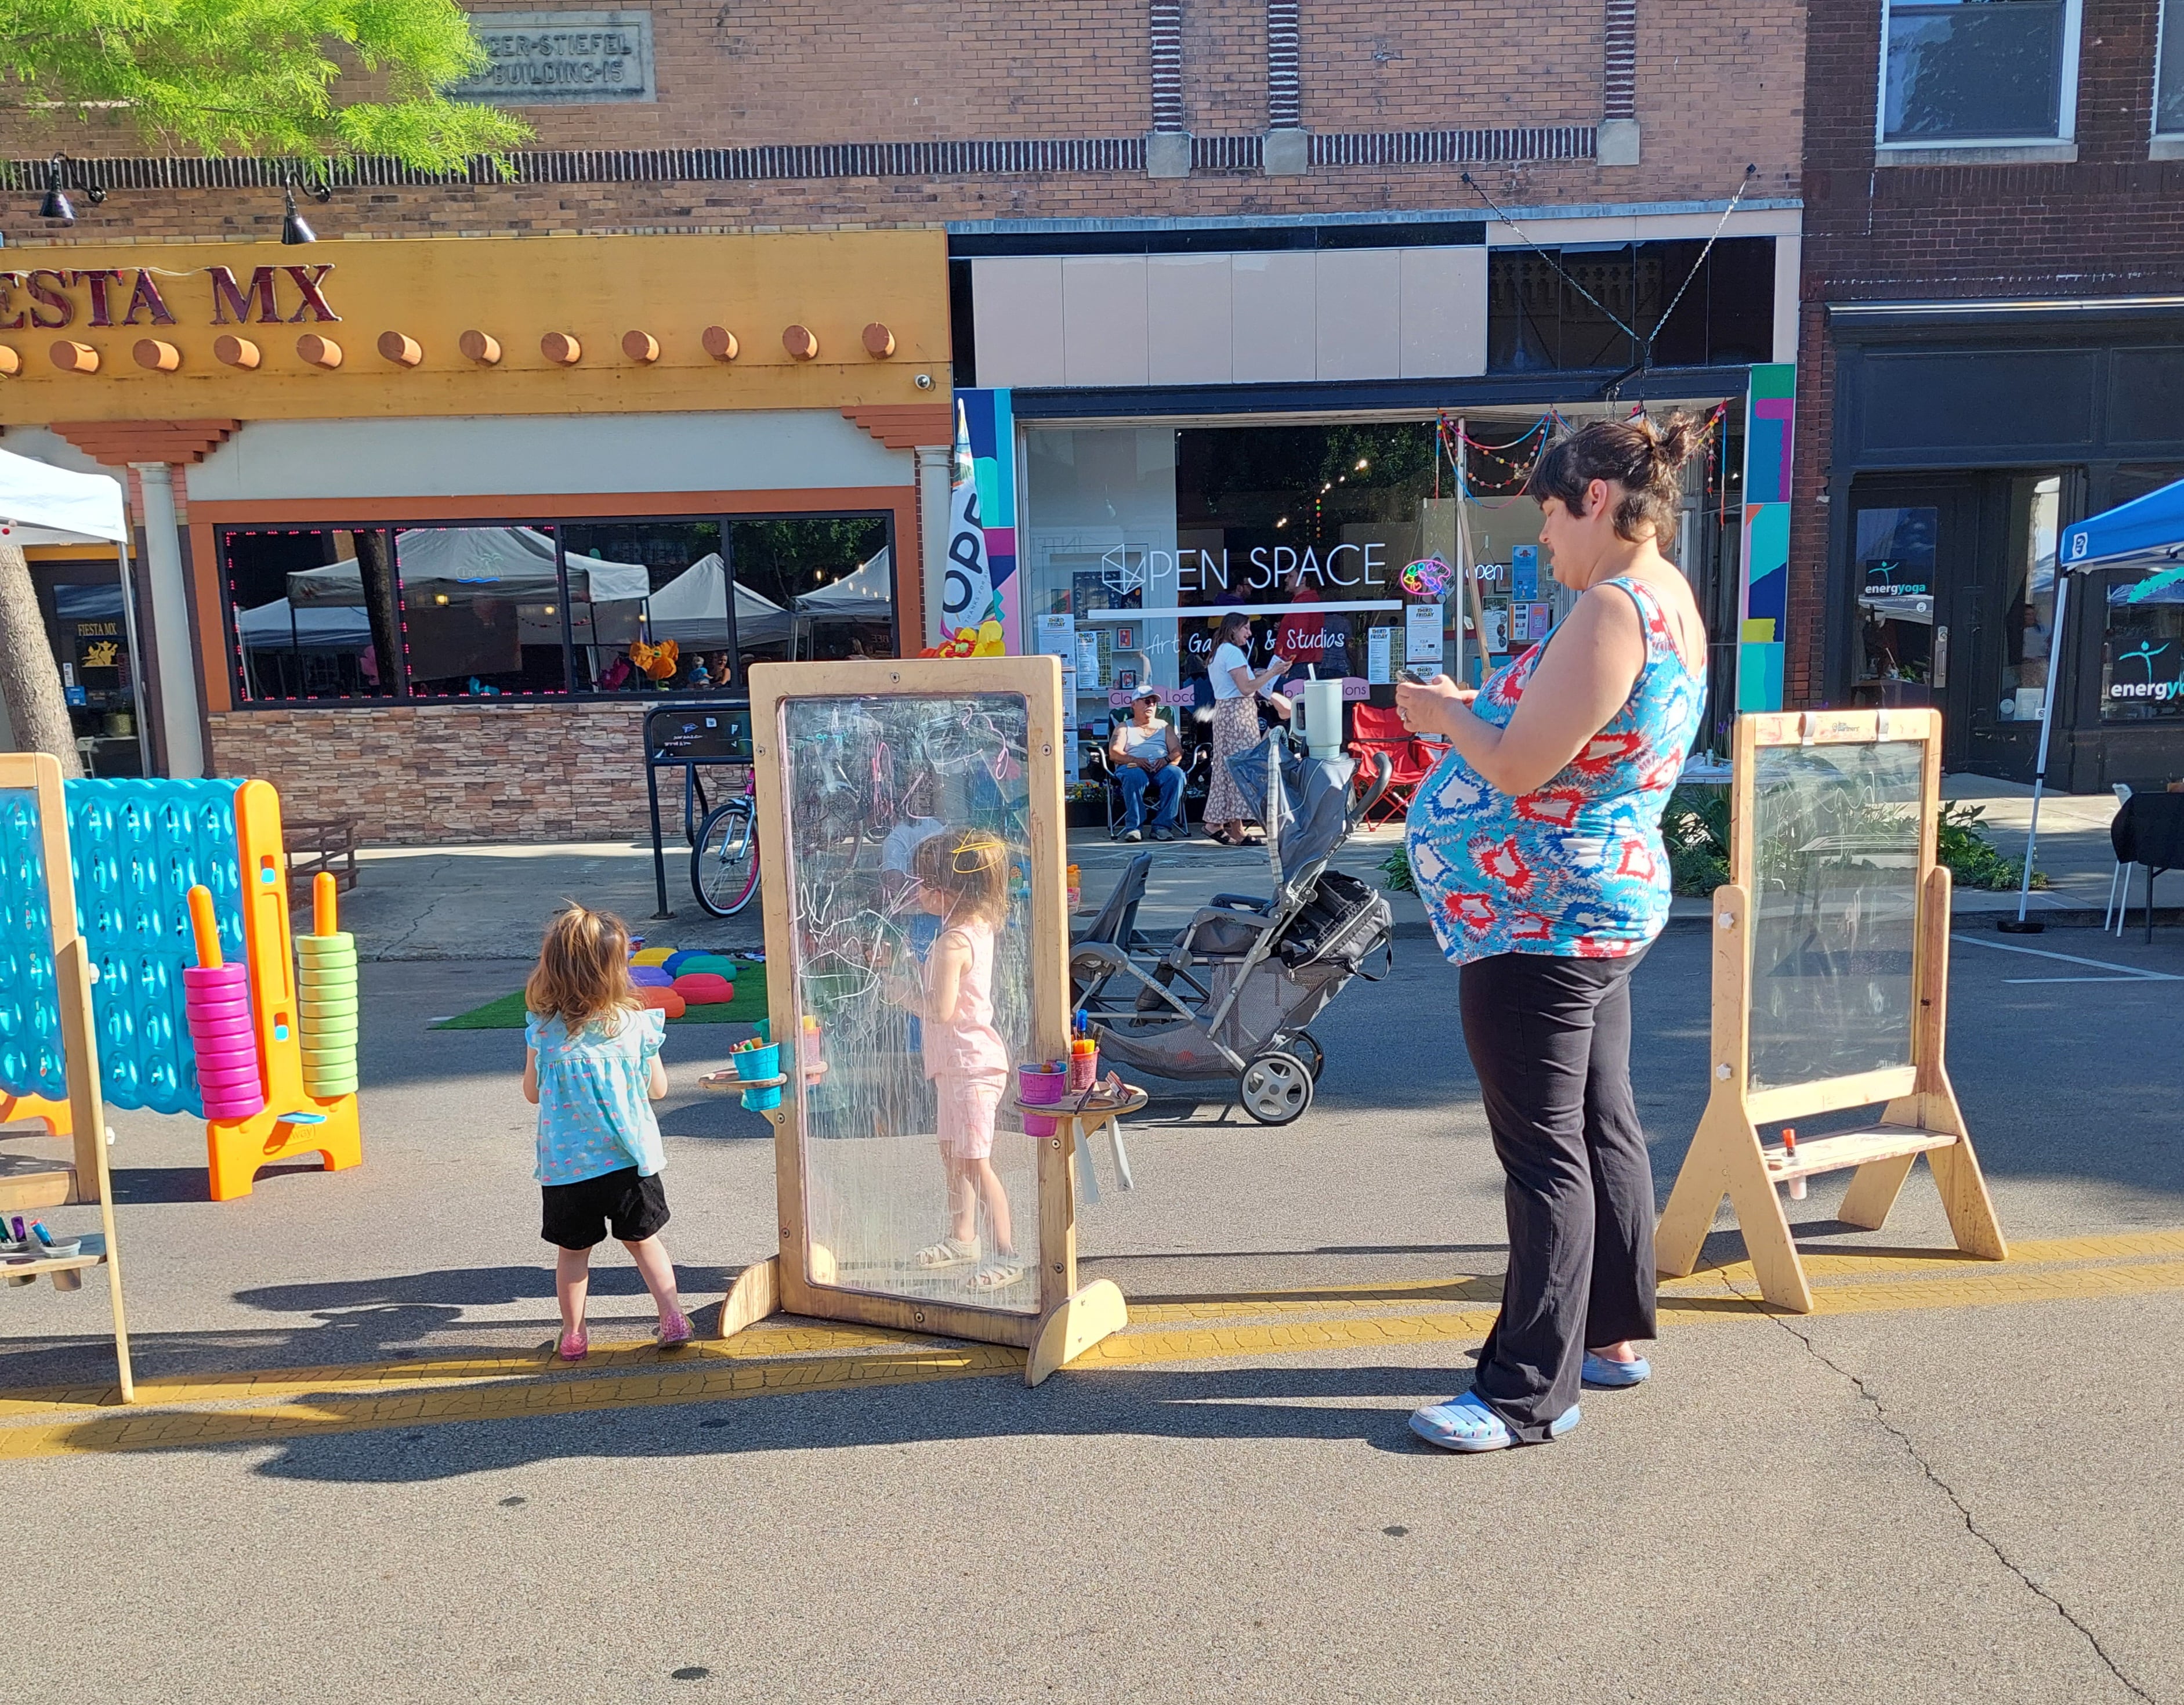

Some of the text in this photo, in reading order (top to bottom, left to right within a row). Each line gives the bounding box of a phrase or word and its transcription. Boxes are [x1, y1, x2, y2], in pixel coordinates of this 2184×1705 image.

[205, 263, 343, 325] MX
[1248, 543, 1386, 589] SPACE
[1865, 584, 1926, 595] energyoga
[965, 597, 980, 623] THANKS
[77, 622, 117, 636] FIESTA MX
[1146, 634, 1180, 655] Art
[1287, 627, 1345, 650] Studios
[1138, 971, 1189, 1015] DUO GLIDER
